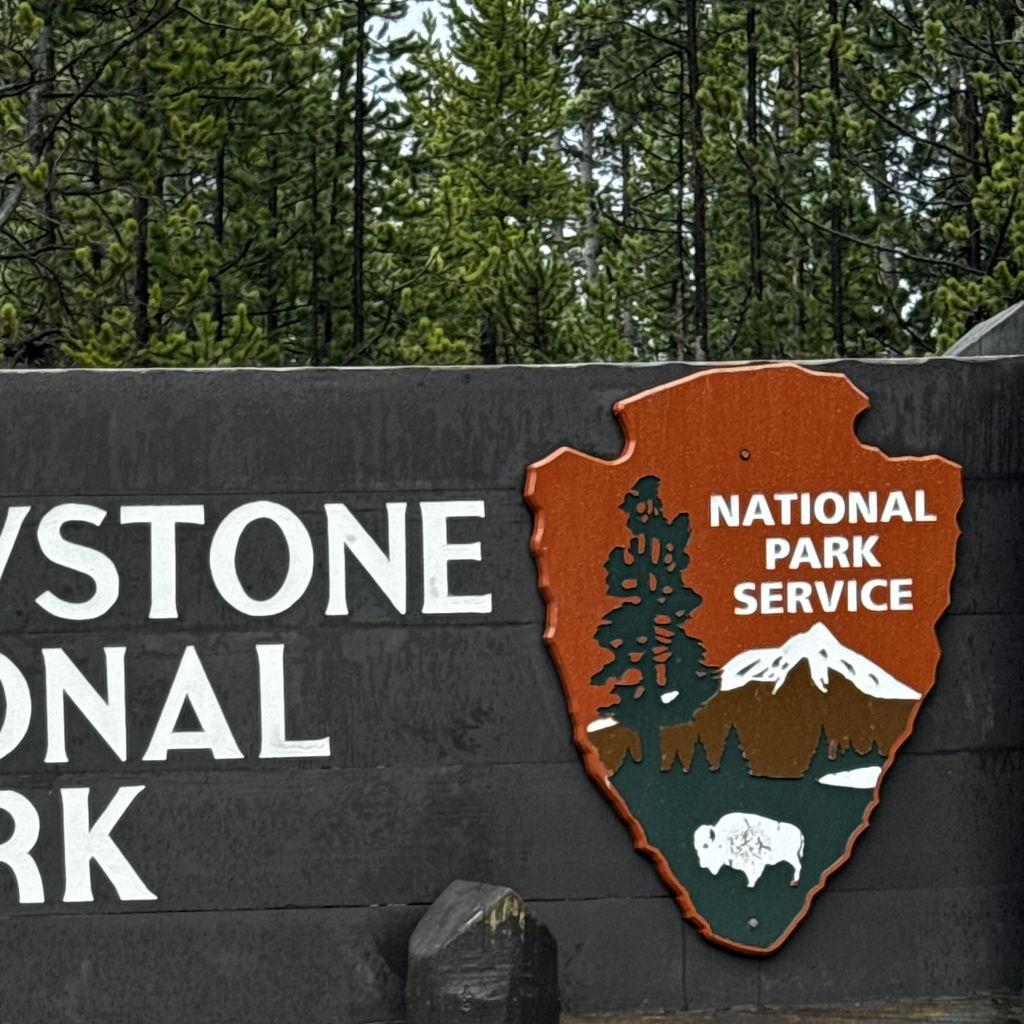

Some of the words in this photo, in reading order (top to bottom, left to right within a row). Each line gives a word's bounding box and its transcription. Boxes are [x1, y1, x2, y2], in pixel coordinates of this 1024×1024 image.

[710, 489, 938, 527] NATIONAL
[764, 535, 882, 570] PARK
[733, 578, 914, 615] SERVICE
